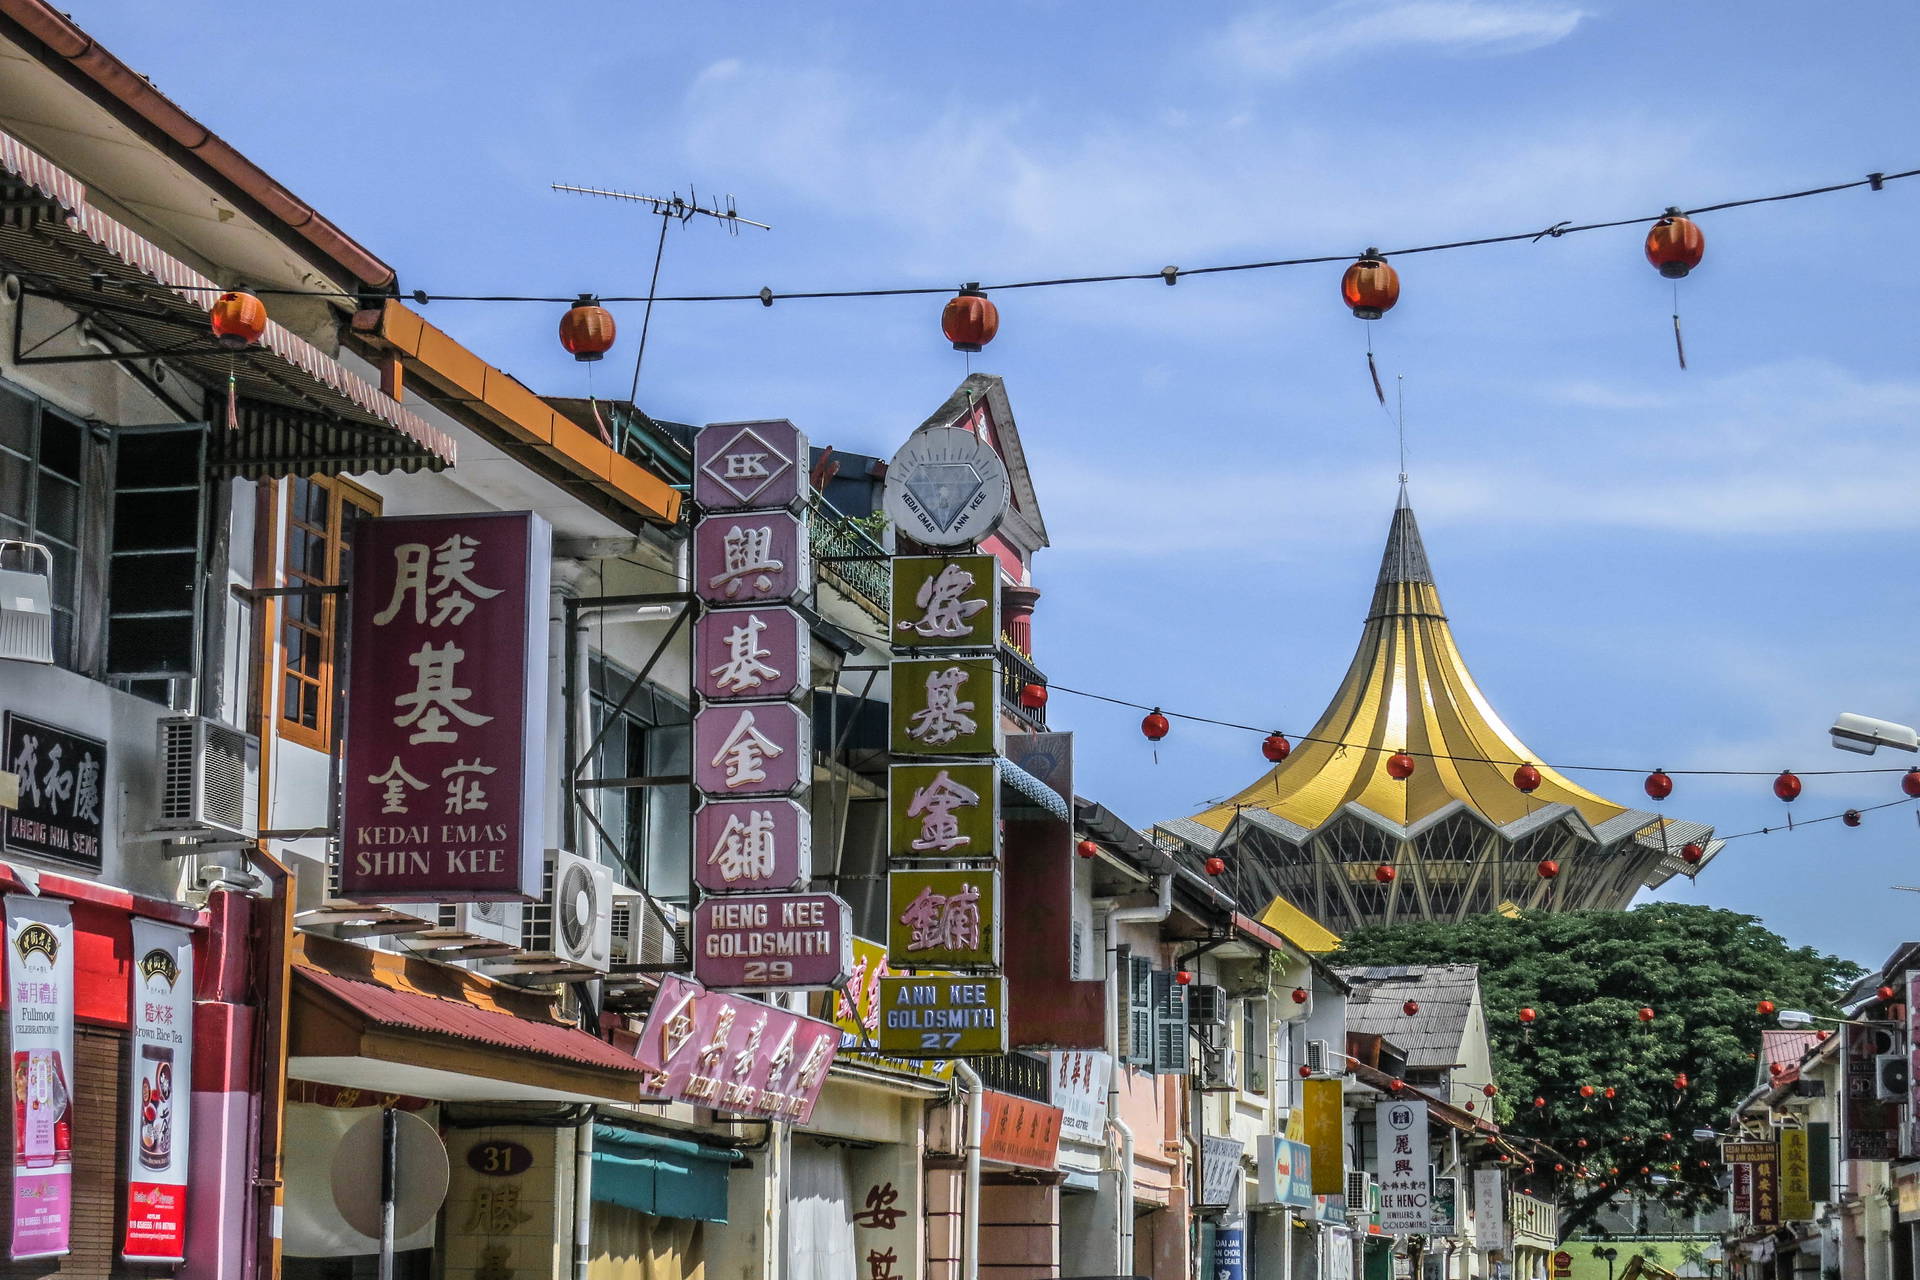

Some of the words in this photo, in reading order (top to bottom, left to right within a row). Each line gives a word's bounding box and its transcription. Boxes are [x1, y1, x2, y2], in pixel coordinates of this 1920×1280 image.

[902, 492, 919, 514] KEDAI
[917, 512, 935, 533] EMAS
[954, 514, 970, 533] ANN
[970, 491, 987, 511] KEE
[12, 816, 46, 844] KHENG
[50, 825, 70, 850] HUA
[73, 832, 98, 857] SENG
[357, 826, 429, 846] KEDAI
[442, 823, 508, 844] EMAS
[355, 851, 430, 876] SHIN
[447, 848, 506, 875] KEE
[711, 903, 768, 930] HENG
[781, 902, 825, 928] KEE
[705, 930, 830, 958] GOLDSMITH
[743, 961, 793, 982] 29
[896, 985, 936, 1006] ANN
[950, 984, 987, 1005] KEE
[887, 1008, 995, 1029] GOLDSMITH
[156, 1027, 171, 1042] Rice
[172, 1030, 183, 1044] Tea
[920, 1032, 962, 1050] 27
[484, 1146, 512, 1171] 31
[1380, 1194, 1393, 1208] LEE
[1416, 1211, 1422, 1220] &
